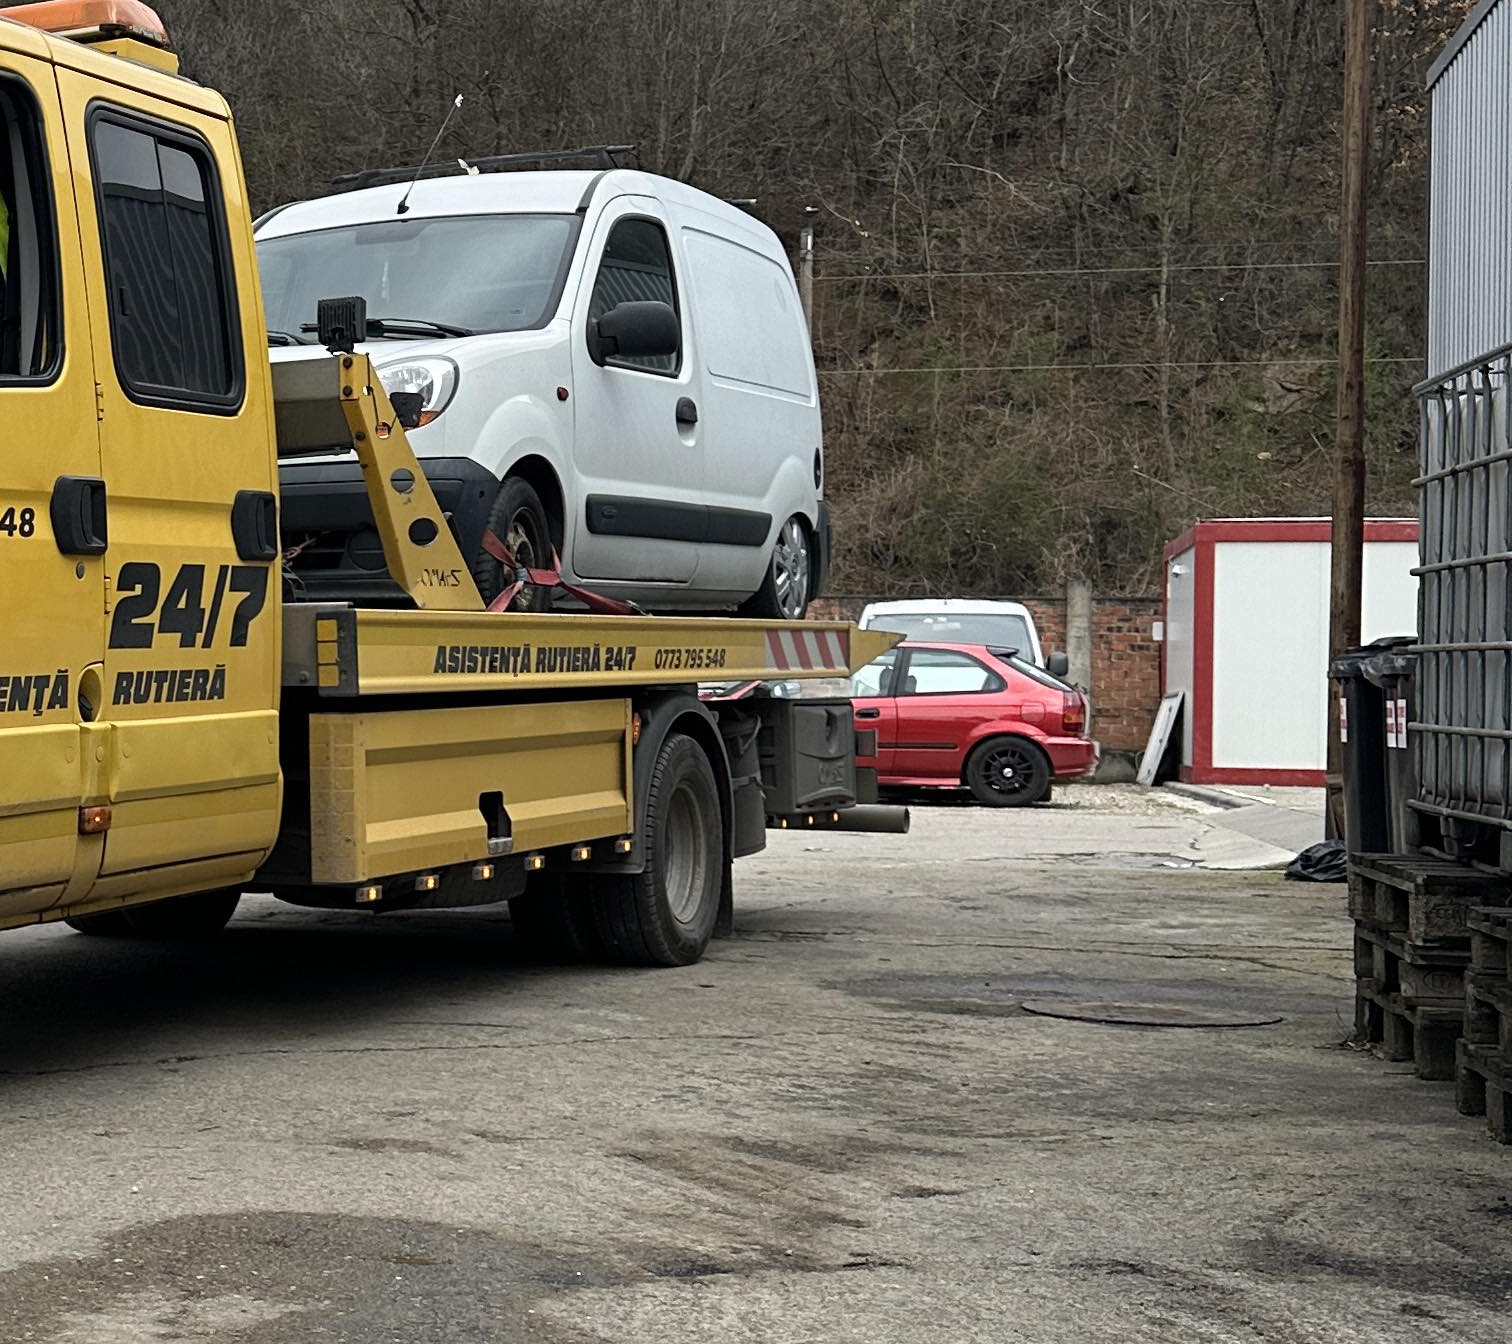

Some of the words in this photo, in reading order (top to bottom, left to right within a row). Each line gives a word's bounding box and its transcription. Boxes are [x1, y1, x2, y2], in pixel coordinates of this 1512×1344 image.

[108, 561, 269, 649] 24/7
[604, 646, 637, 672] 24/7
[654, 648, 682, 669] 0773
[683, 648, 704, 668] 795
[705, 648, 726, 668] 548
[112, 663, 226, 706] RUTIERĂ
